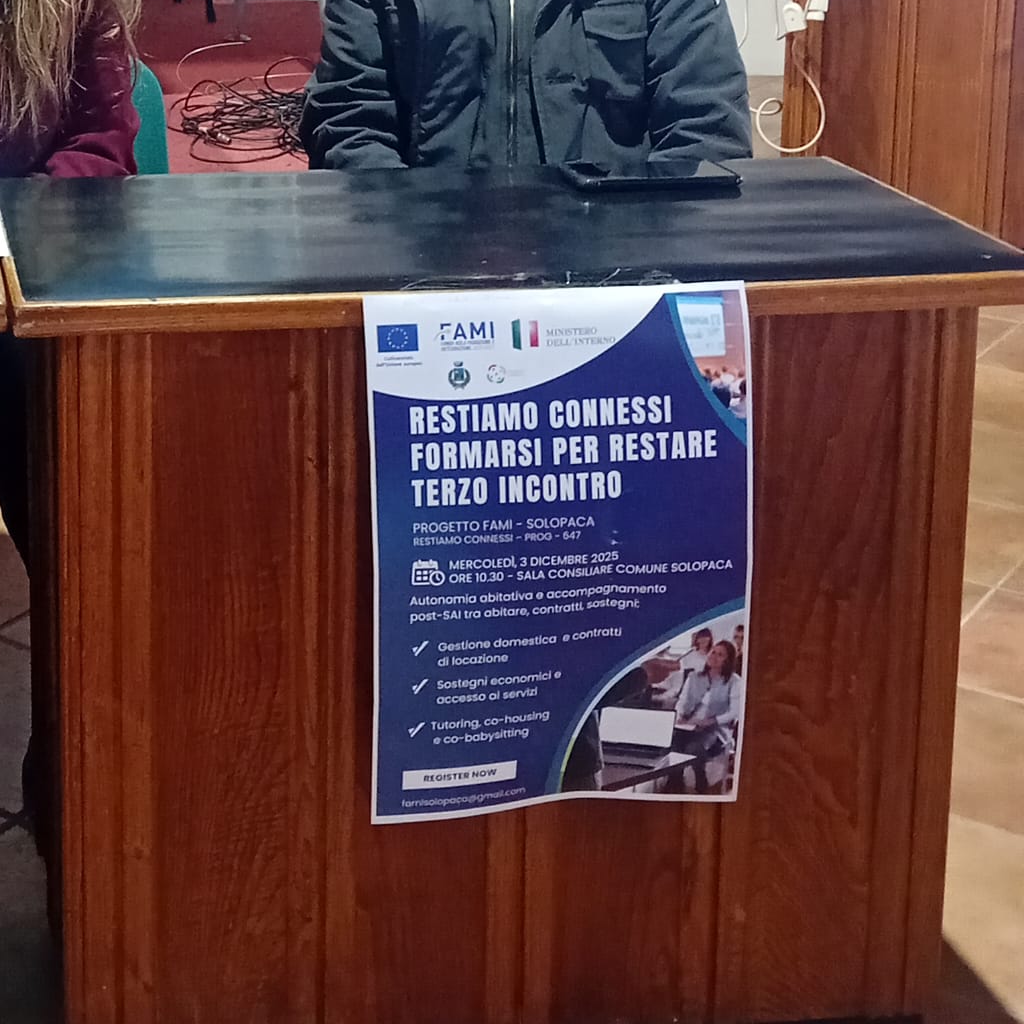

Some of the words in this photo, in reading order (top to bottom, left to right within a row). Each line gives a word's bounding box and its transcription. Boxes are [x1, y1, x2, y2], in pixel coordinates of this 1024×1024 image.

[440, 321, 495, 340] FAMI
[546, 328, 597, 336] MINISTERO
[409, 401, 538, 435] RESTIAMO
[548, 395, 672, 428] CONNESSI
[410, 437, 542, 471] FORMARSI
[553, 435, 599, 465] PER
[609, 429, 717, 462] RESTARE
[411, 477, 488, 507] TERZO
[499, 470, 622, 504] INCONTRO
[413, 521, 480, 533] PROGETTO
[483, 520, 513, 530] FAMI
[526, 516, 595, 530] SOLOPACA
[520, 557, 527, 567] 3
[530, 554, 589, 567] DICEMBRE
[591, 551, 619, 562] 2025
[449, 573, 473, 584] ORE
[475, 572, 504, 583] 10.30
[516, 569, 545, 581] SALA
[548, 565, 613, 579] CONSILIARE
[616, 562, 669, 574] COMUNE
[671, 559, 733, 573] SOLOPACA
[410, 594, 476, 606] Autonomia
[479, 590, 533, 604] abitativa
[536, 591, 544, 599] e
[546, 583, 667, 600] accompagnamento
[409, 610, 462, 624] post-SAI
[464, 608, 481, 619] tra
[484, 604, 530, 619] abitare,
[532, 601, 584, 616] contratti,
[587, 598, 639, 610] sostegni:
[438, 639, 491, 653] Gestione
[493, 634, 557, 649] domestica
[563, 633, 570, 642] e
[572, 626, 622, 641] contratti
[438, 655, 449, 667] di
[452, 652, 509, 666] locazione
[437, 675, 488, 691] Sostegni
[490, 670, 551, 685] economici
[554, 669, 561, 679] e
[436, 692, 486, 705] accesso
[489, 690, 500, 700] ai
[503, 686, 538, 700] servizi
[431, 717, 482, 732] Tutoring,
[484, 709, 550, 727] co-housing
[433, 735, 441, 745] e
[443, 726, 529, 745] co-babysitting
